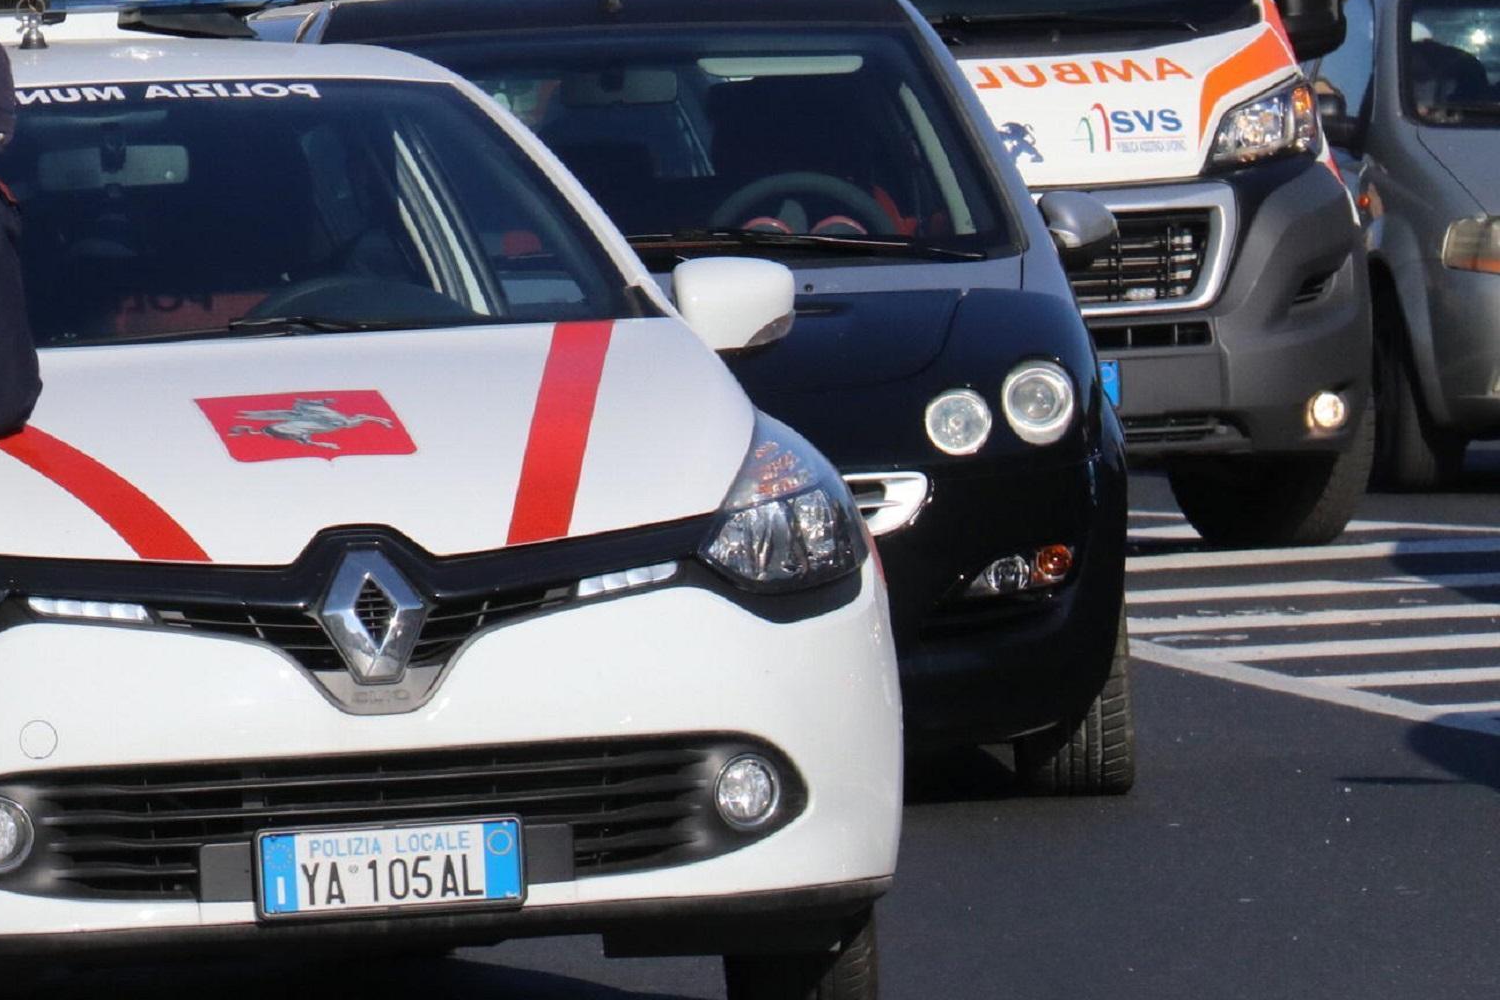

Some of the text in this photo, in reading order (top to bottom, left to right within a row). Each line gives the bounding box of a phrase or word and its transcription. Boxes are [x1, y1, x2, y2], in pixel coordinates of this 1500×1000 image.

[1110, 108, 1183, 133] SVS
[309, 830, 471, 858] POLIZIA LOCALE
[301, 861, 346, 906] YA
